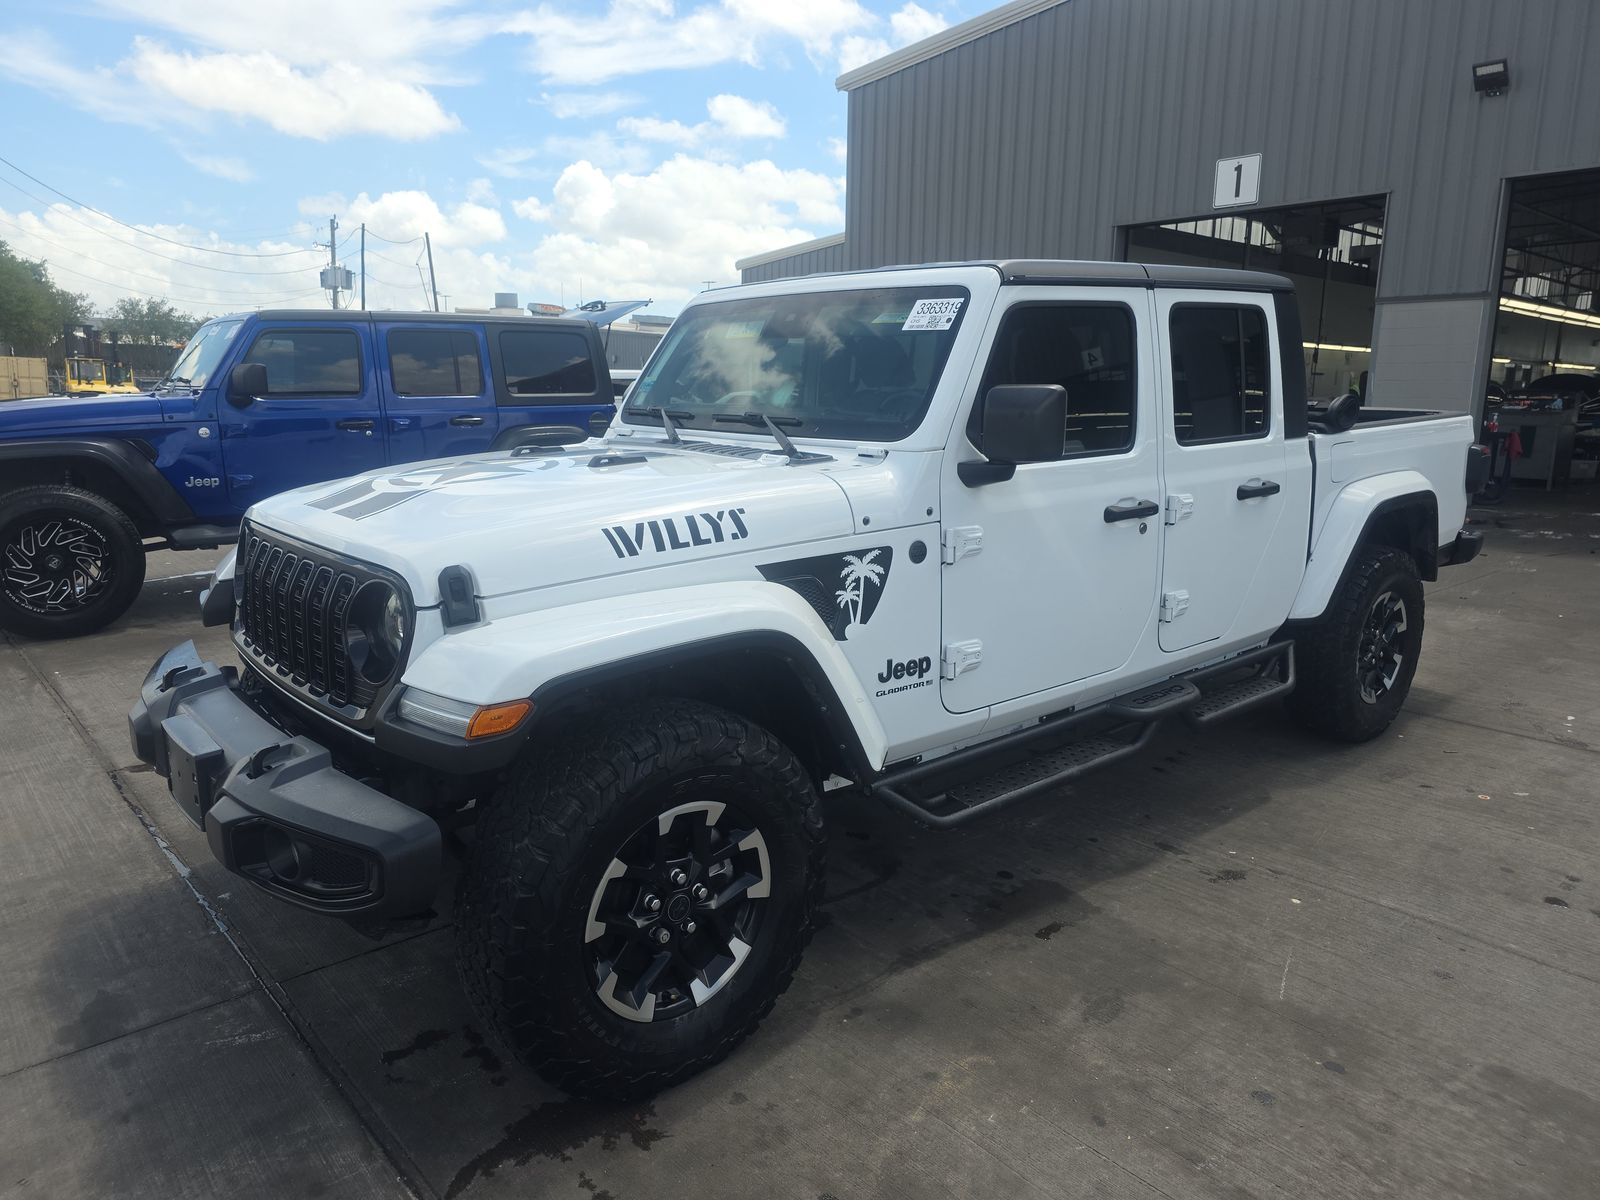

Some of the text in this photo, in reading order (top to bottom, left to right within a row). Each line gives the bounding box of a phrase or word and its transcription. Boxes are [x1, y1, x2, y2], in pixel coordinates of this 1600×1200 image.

[1234, 163, 1243, 198] 1
[916, 301, 963, 315] 3363319
[184, 476, 220, 488] Jeep
[601, 507, 749, 559] WILLYS
[877, 656, 932, 683] Jeep
[875, 681, 925, 697] GLADIATOR
